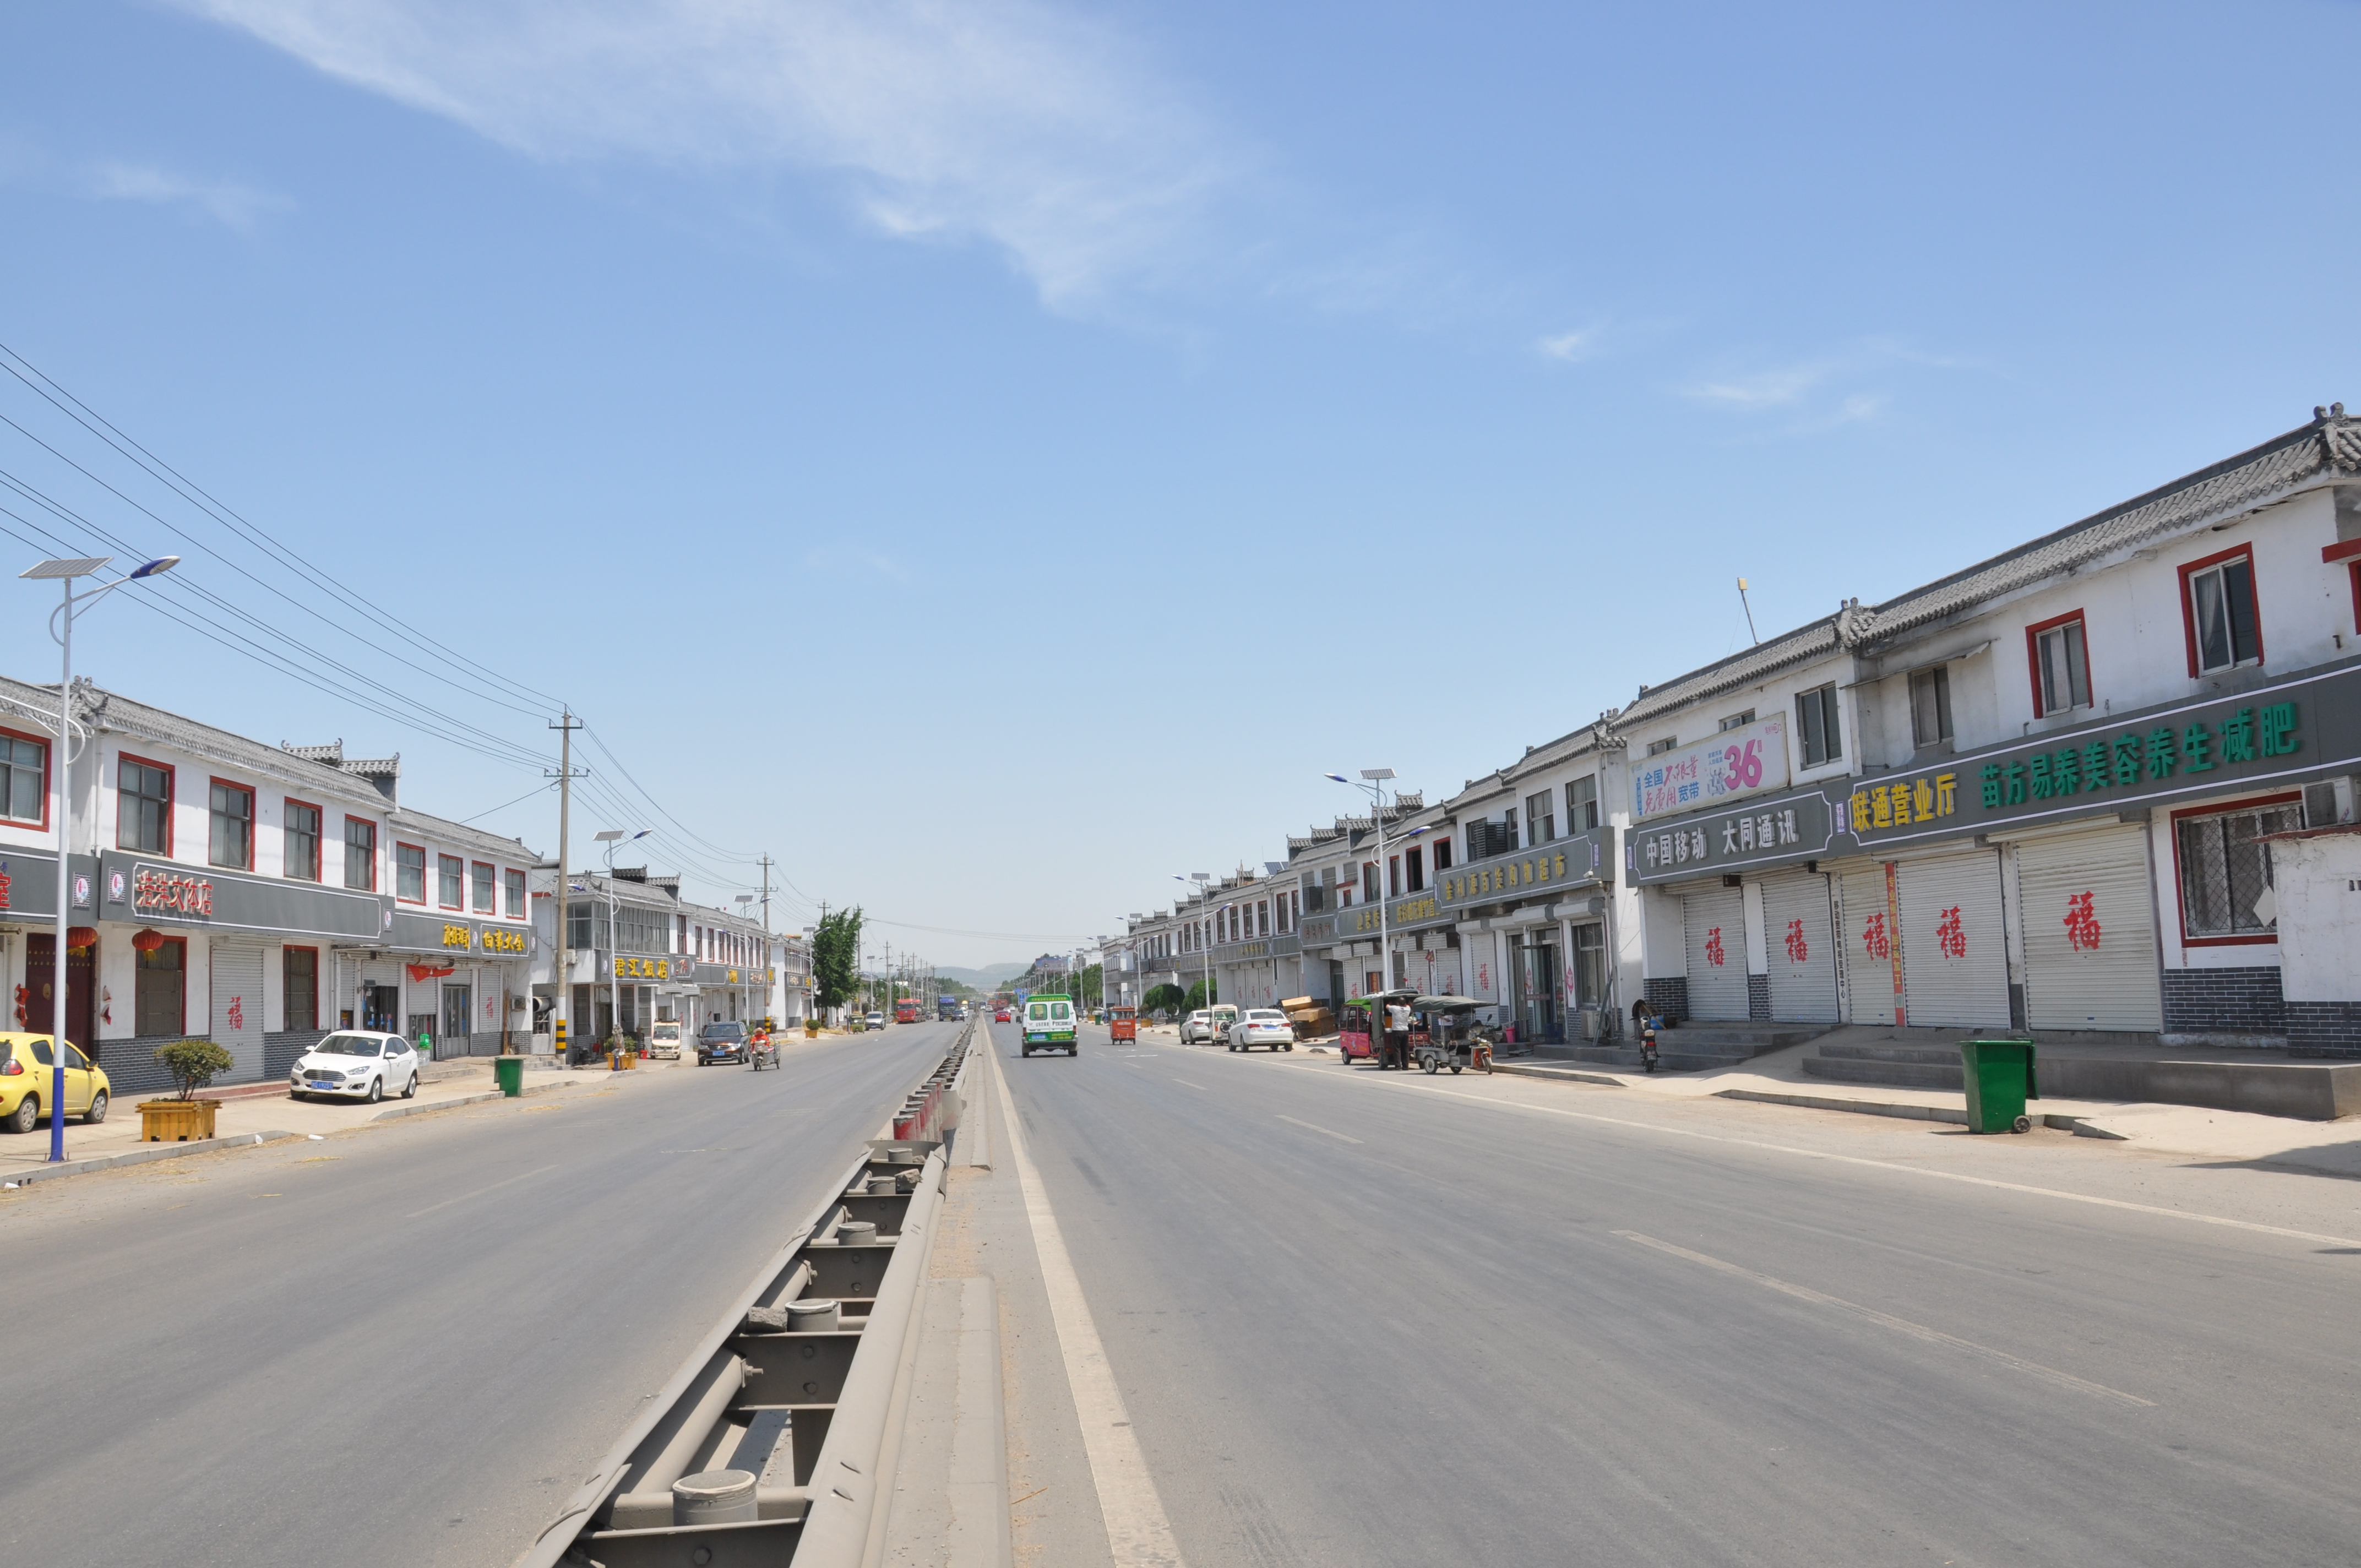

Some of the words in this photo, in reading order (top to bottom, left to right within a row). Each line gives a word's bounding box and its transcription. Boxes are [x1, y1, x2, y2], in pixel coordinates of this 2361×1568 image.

[1724, 739, 1762, 790] 36
[1979, 701, 2300, 808] 苗方易养美容养生减肥
[1851, 772, 1957, 832] 联通营业厅
[1646, 827, 1707, 868] 中国移动
[1722, 809, 1799, 855] 大同通讯
[614, 958, 668, 979] 君汇饭店
